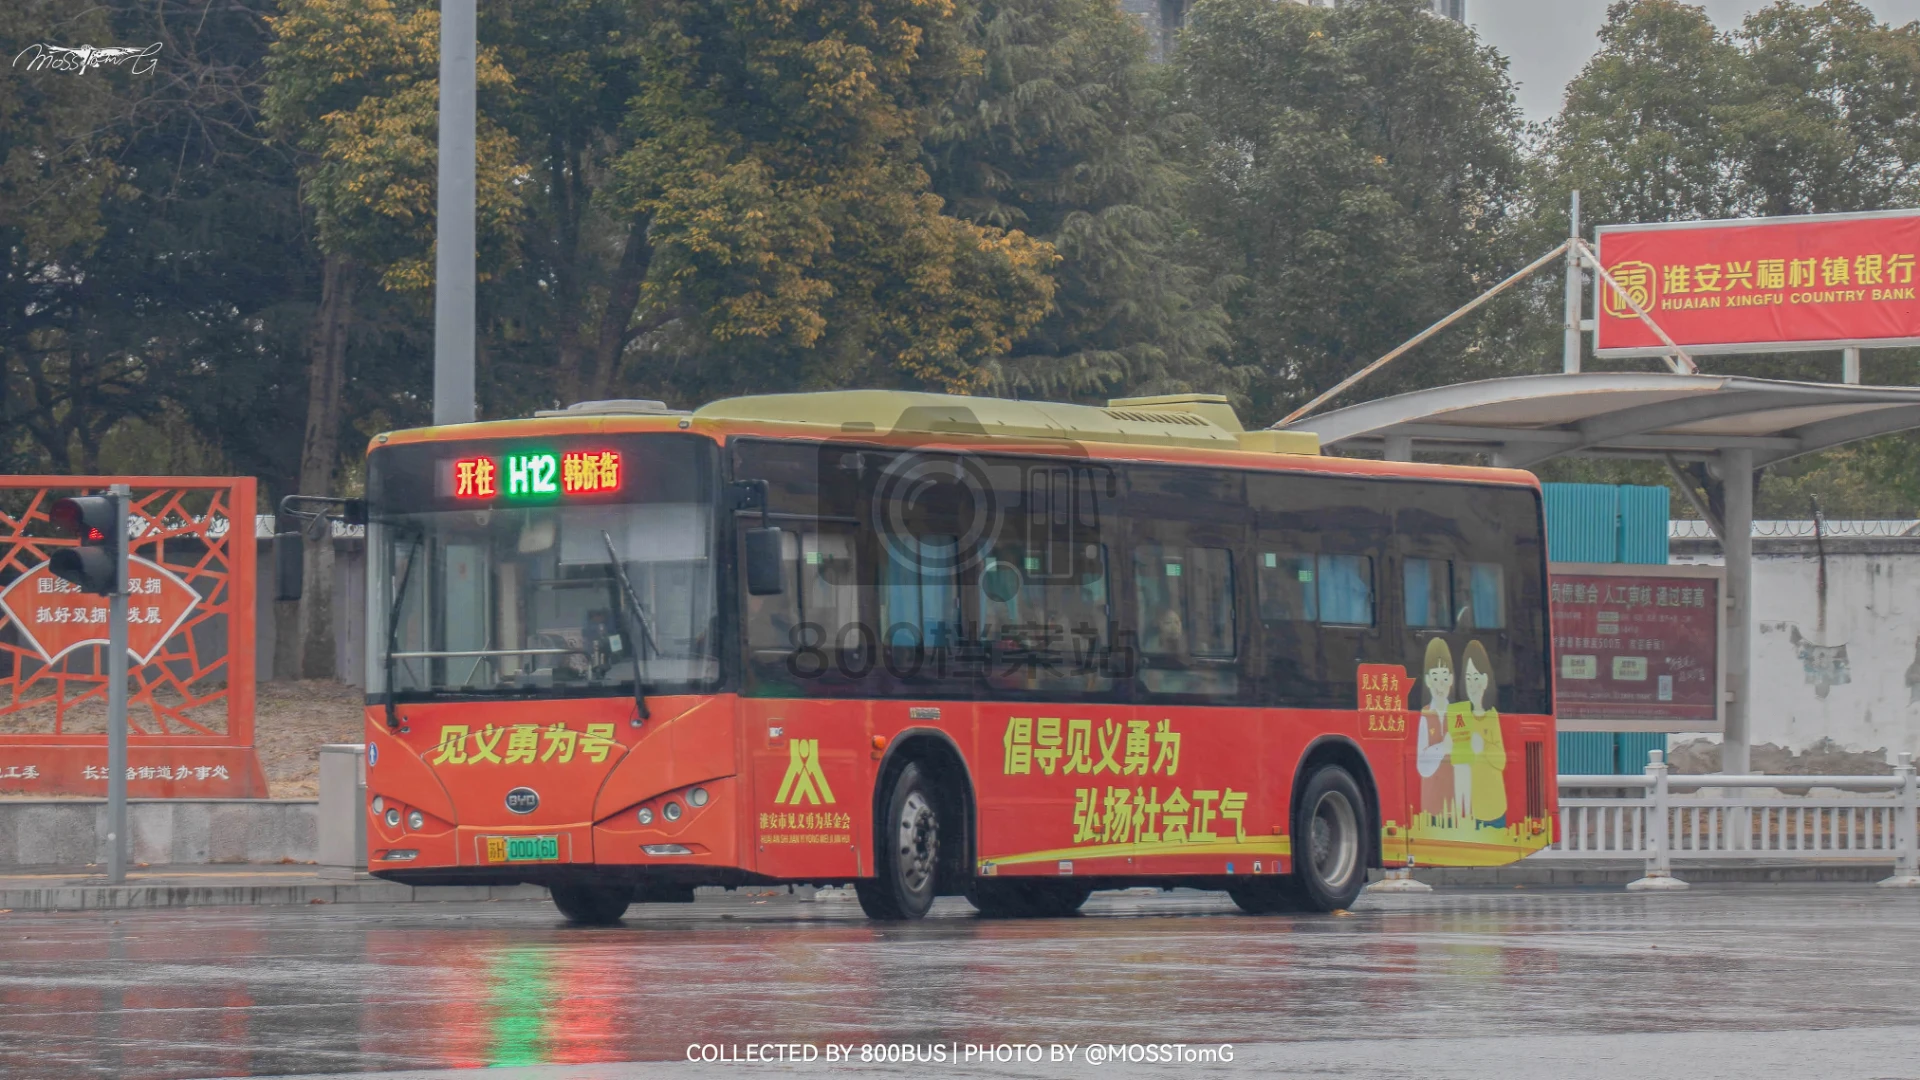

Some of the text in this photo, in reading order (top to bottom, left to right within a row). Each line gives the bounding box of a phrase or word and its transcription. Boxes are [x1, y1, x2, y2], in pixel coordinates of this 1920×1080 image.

[1662, 252, 1917, 296] 淮安兴福村镇银行
[1661, 287, 1917, 311] HUAIAN XINGFU COUNTRY BANK
[457, 458, 495, 496] 开往
[509, 454, 557, 494] H12
[1603, 585, 1652, 607] 人工审核
[1656, 586, 1705, 608] 通过率高
[36, 606, 162, 624] 抓好双拥发展
[432, 722, 617, 766] 见义勇为号
[1003, 716, 1181, 776] 倡导见义勇为
[0, 765, 40, 780] 工委
[508, 794, 536, 806] BYD
[1073, 785, 1249, 844] 弘扬社会正气
